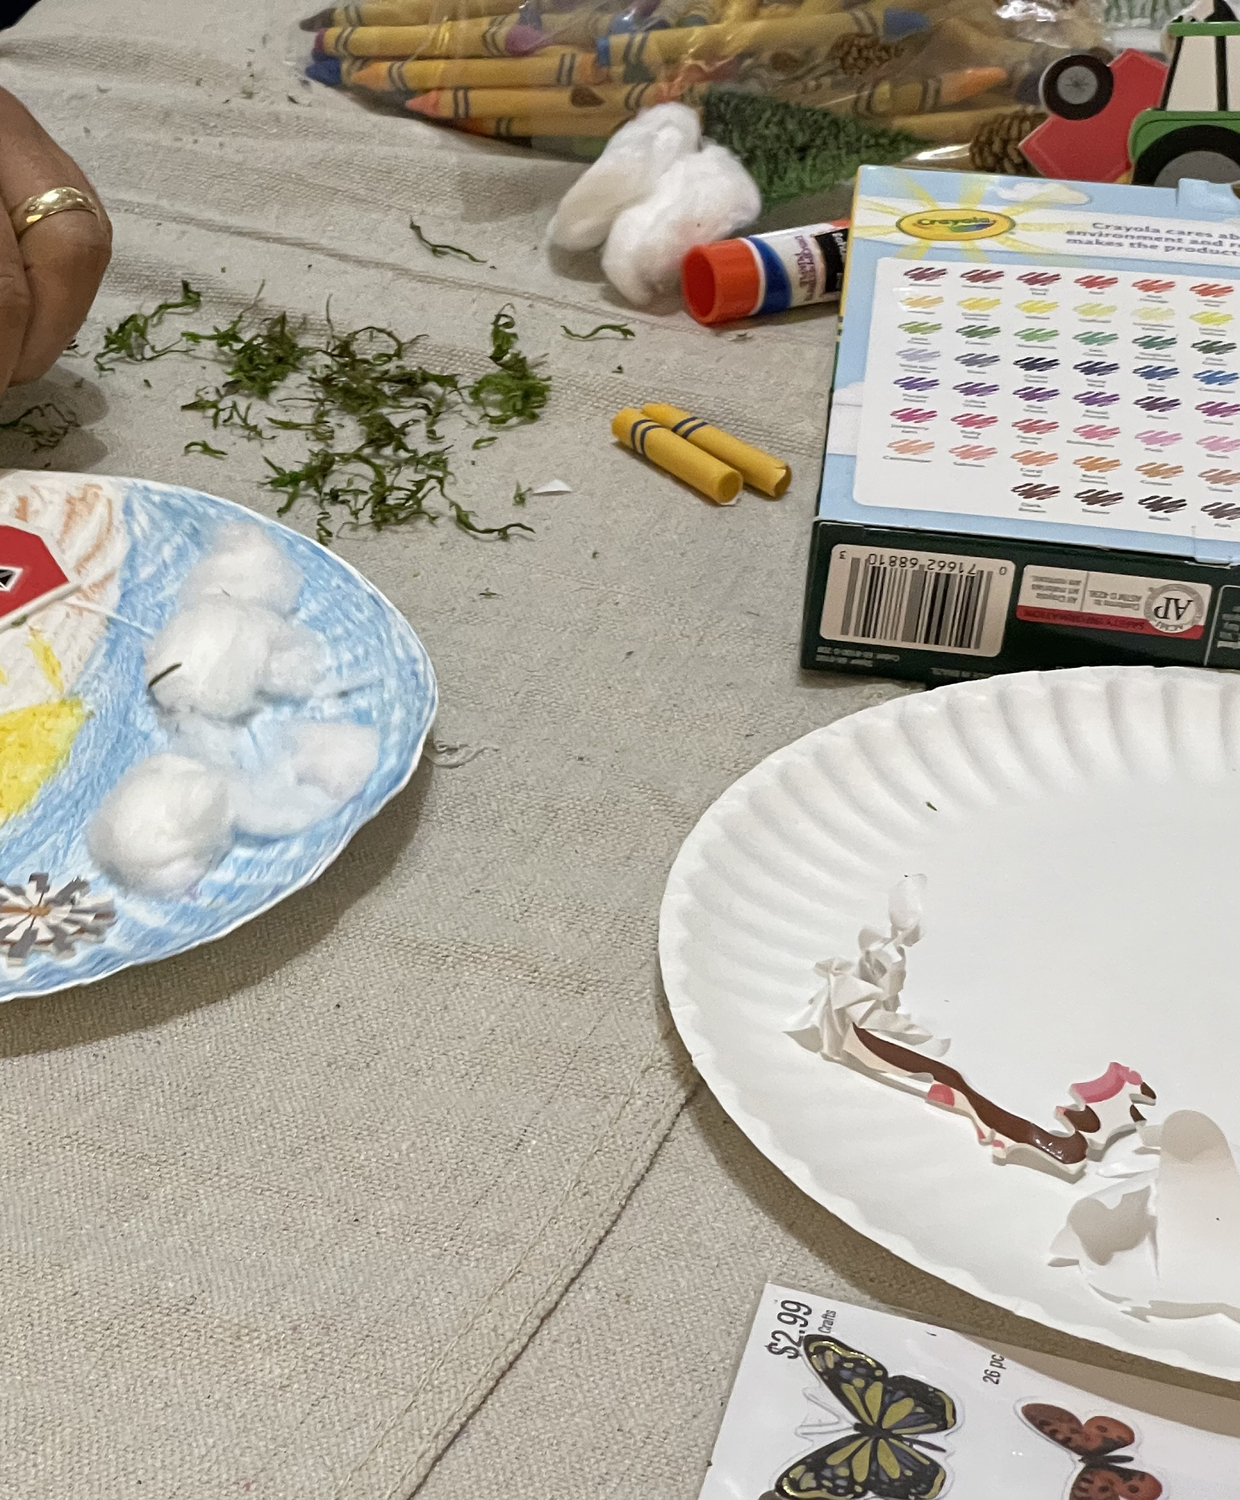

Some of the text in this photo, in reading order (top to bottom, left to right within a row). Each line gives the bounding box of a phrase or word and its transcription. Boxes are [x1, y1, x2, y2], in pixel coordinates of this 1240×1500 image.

[917, 217, 990, 227] Crayola
[1092, 222, 1161, 234] Crayola
[1165, 229, 1214, 238] cares
[1066, 229, 1184, 244] environment
[1189, 239, 1224, 247] and
[1066, 238, 1124, 247] makes
[1129, 241, 1159, 250] the
[839, 550, 1007, 576] 0 71662 68810 3
[1153, 597, 1194, 621] AP
[764, 1300, 812, 1359] $2.99
[818, 1310, 836, 1333] Crafts
[982, 1369, 1001, 1385] 26
